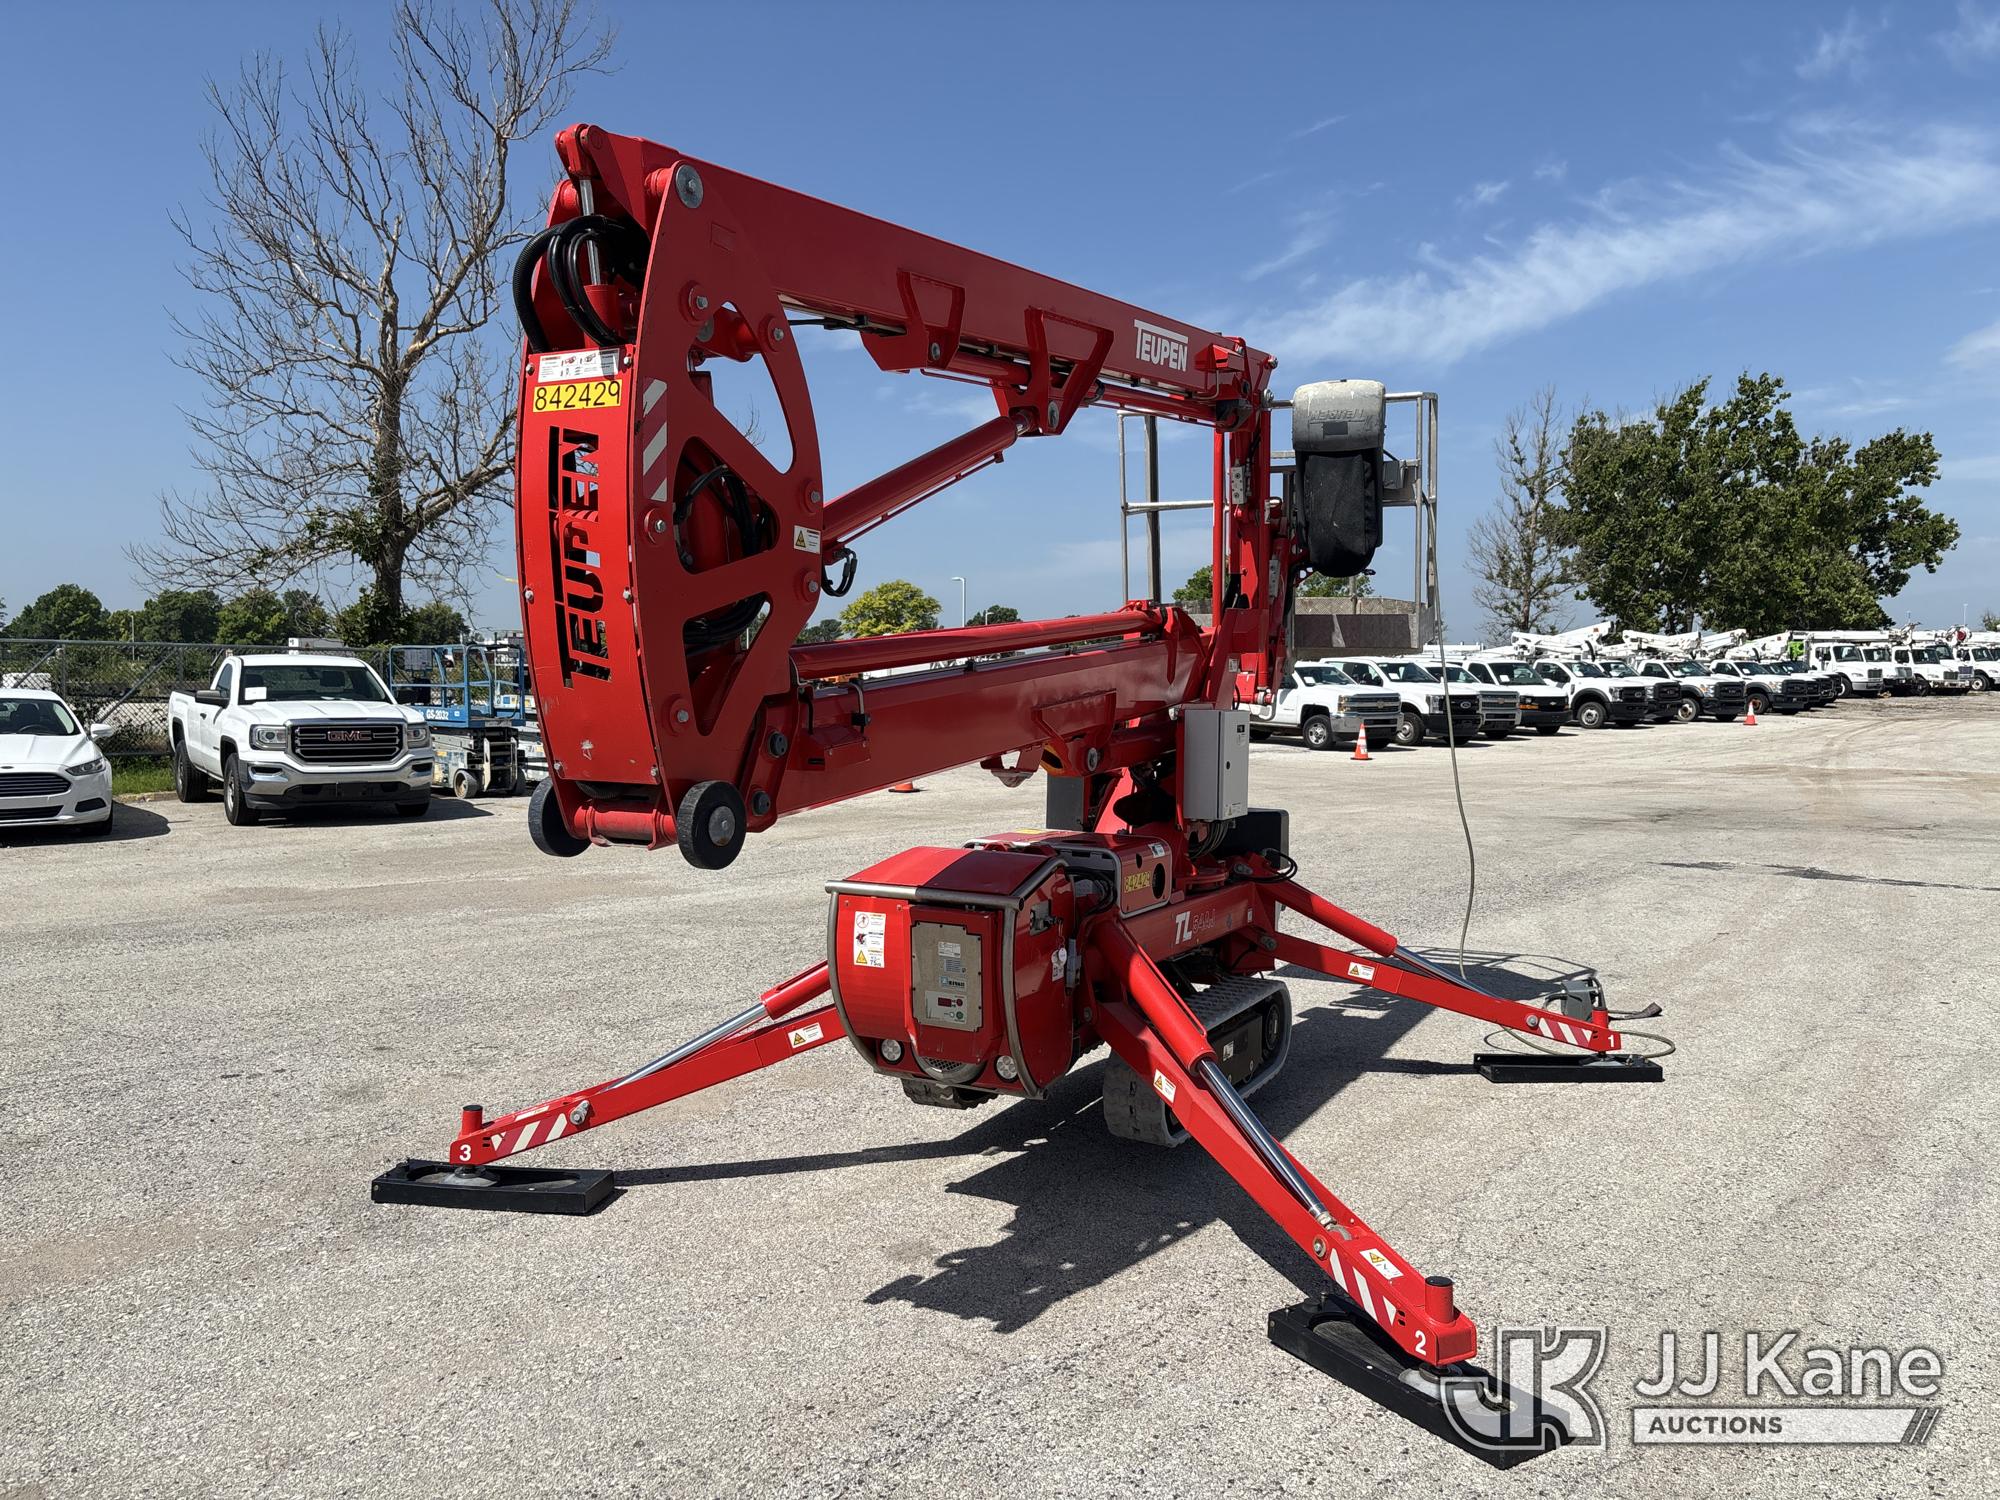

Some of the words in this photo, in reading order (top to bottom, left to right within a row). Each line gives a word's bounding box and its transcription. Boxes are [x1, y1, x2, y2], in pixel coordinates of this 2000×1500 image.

[1134, 319, 1189, 372] TEUPEN
[535, 381, 620, 411] 842429
[548, 425, 613, 690] TEUPEN
[328, 730, 372, 741] GMC
[1175, 911, 1193, 945] TL
[1607, 1034, 1615, 1048] 1
[459, 1144, 472, 1162] 3
[1415, 1330, 1427, 1356] 2
